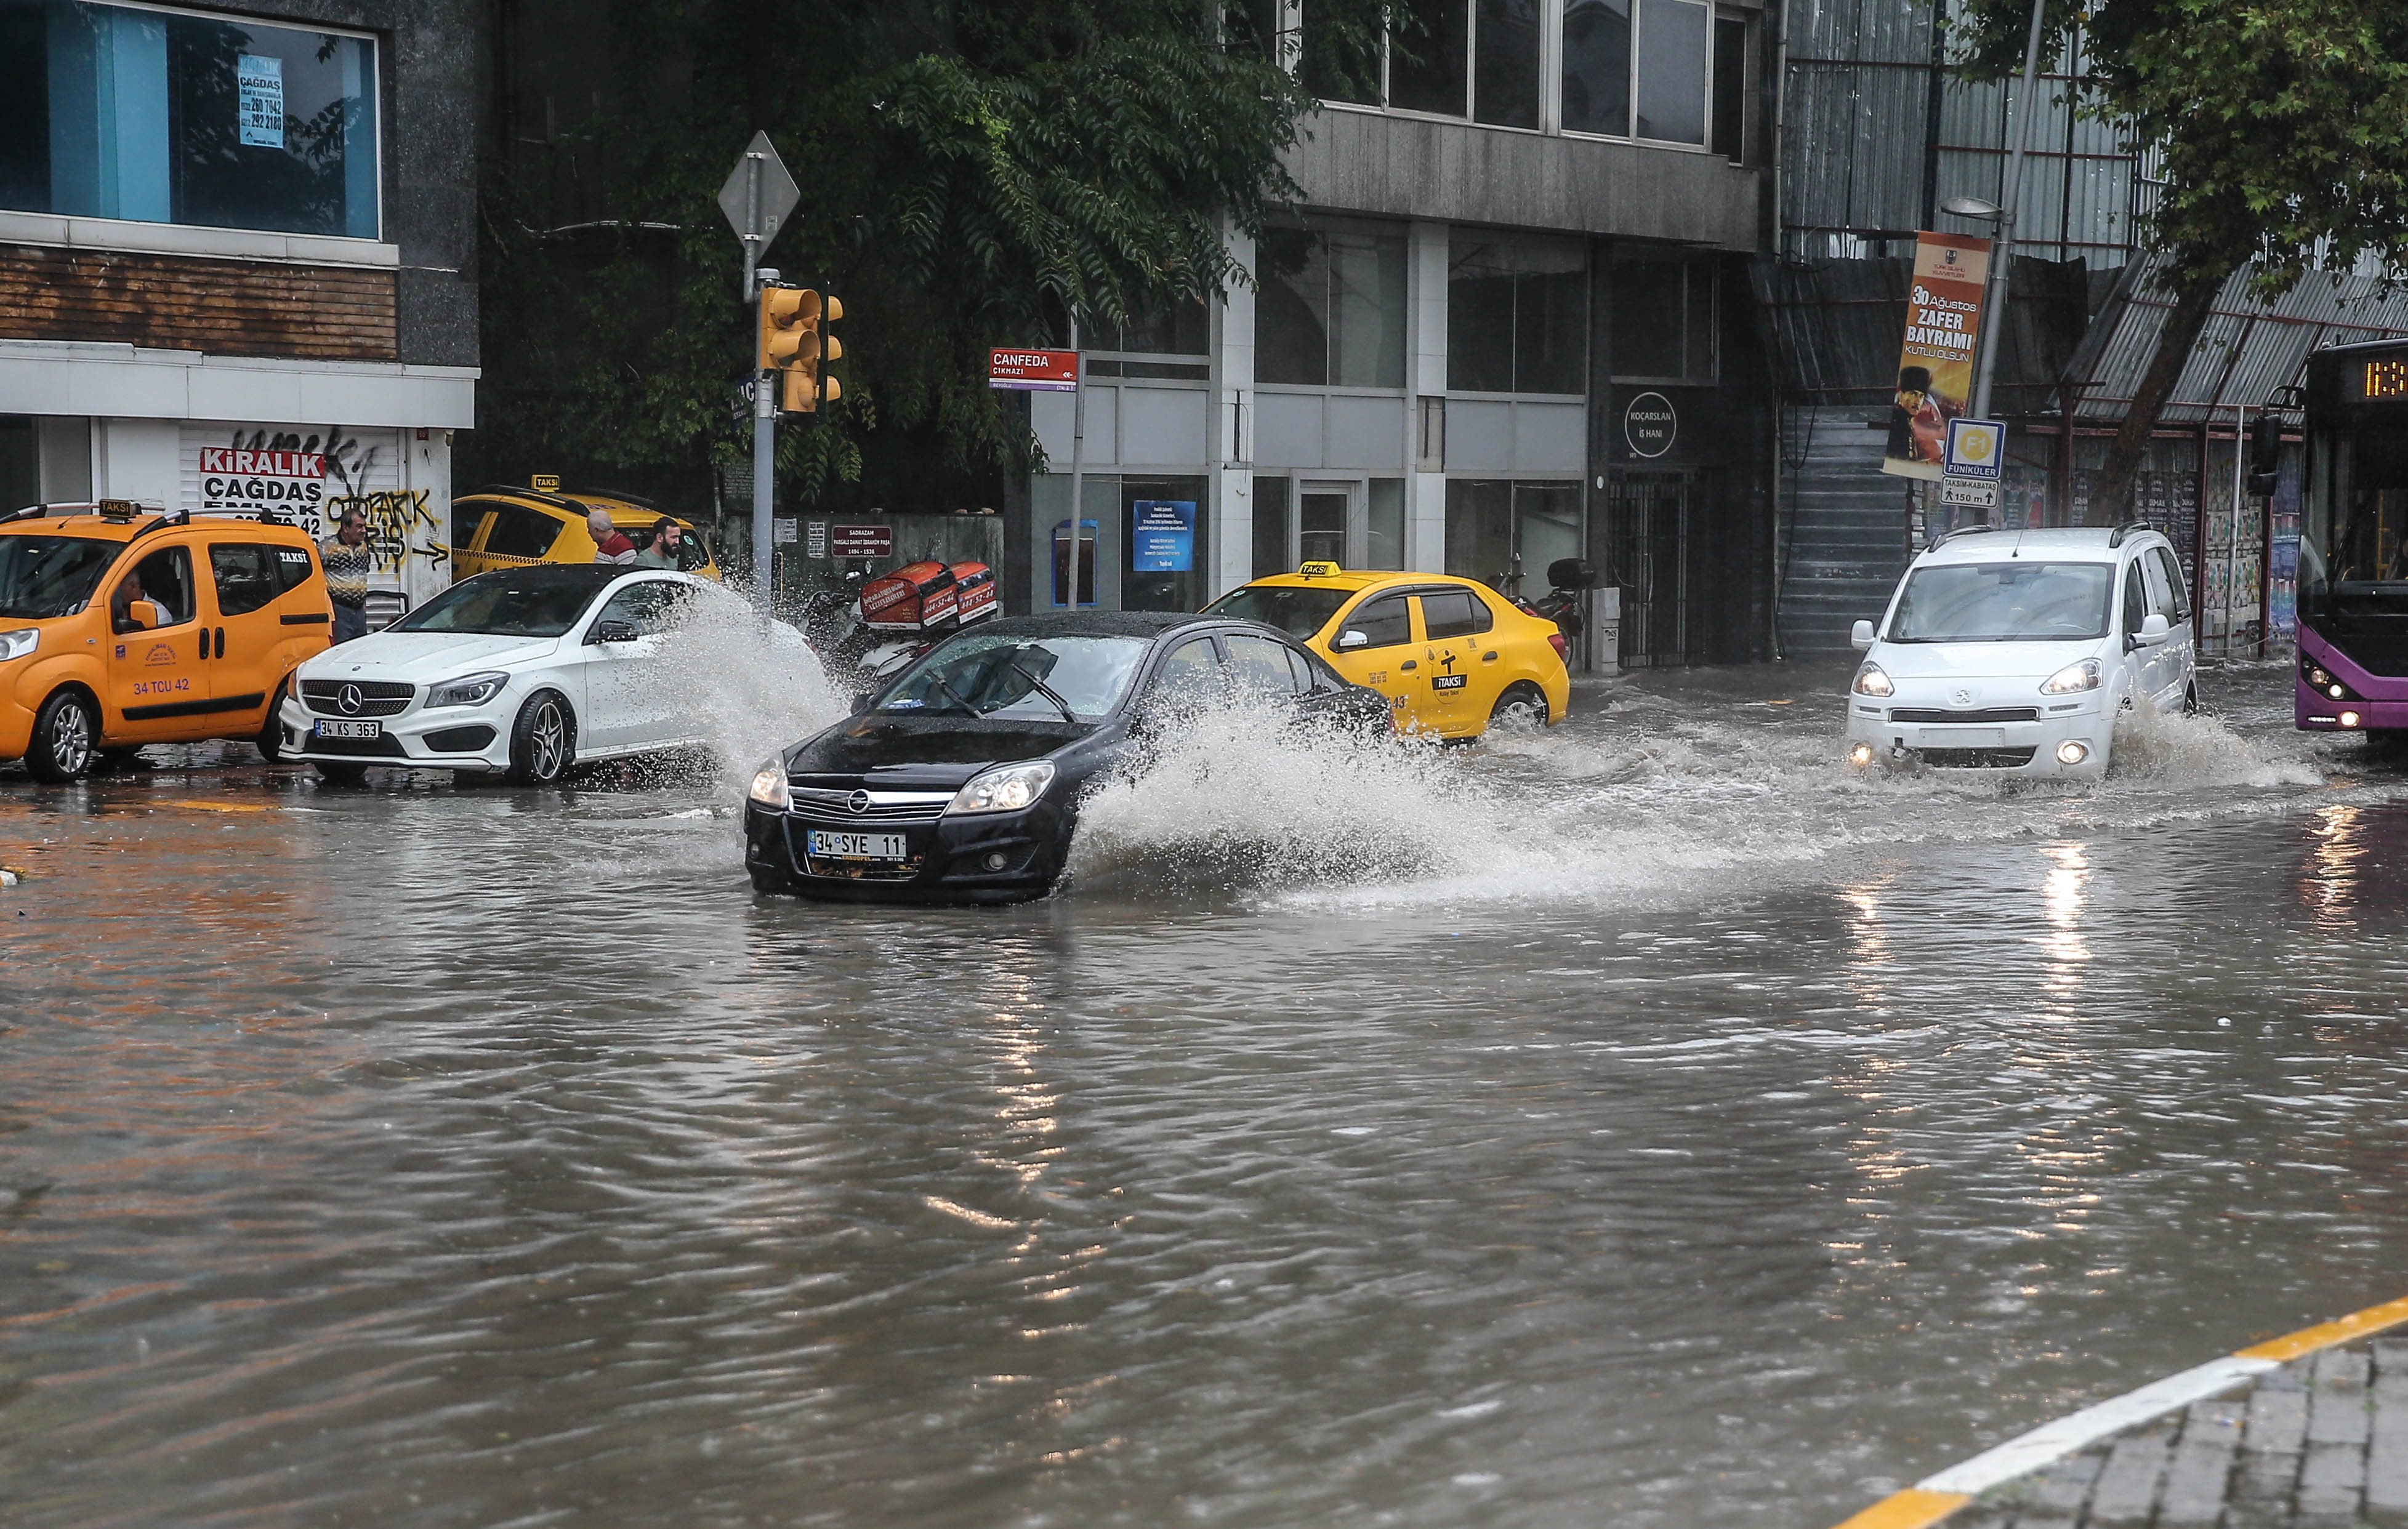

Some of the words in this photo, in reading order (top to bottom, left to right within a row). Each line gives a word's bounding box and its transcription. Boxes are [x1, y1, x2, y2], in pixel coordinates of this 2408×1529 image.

[240, 76, 280, 92] ÇAĞDAŞ
[251, 98, 264, 113] 260
[265, 100, 281, 115] 7042
[251, 113, 264, 129] 292
[265, 116, 282, 130] 2180
[1912, 285, 1930, 306] 30
[1929, 295, 1978, 313] Ağustos
[1917, 308, 1964, 331] ZAFER
[1906, 325, 1973, 351] BAYRAMI
[994, 353, 1049, 367] CANFEDA
[1905, 345, 1936, 358] KUTLU
[1936, 350, 1970, 362] OLSUN
[1630, 412, 1671, 422] KOÇARSLAN
[1646, 429, 1663, 438] HANI
[1965, 436, 1987, 454] F1
[1948, 464, 1997, 476] FÜNİKÜLER
[204, 477, 322, 505] ÇAĞDAŞ
[1944, 479, 1997, 492] TAKSİM-KABATAŞ
[1955, 492, 1971, 502] 150
[134, 682, 148, 695] 34
[150, 680, 172, 694] TCU
[175, 678, 190, 691] 42
[321, 722, 332, 735] 34
[337, 722, 350, 736] KS
[356, 723, 377, 737] 363
[816, 833, 833, 852] 34
[842, 835, 869, 854] SYE
[882, 837, 900, 855] 11
